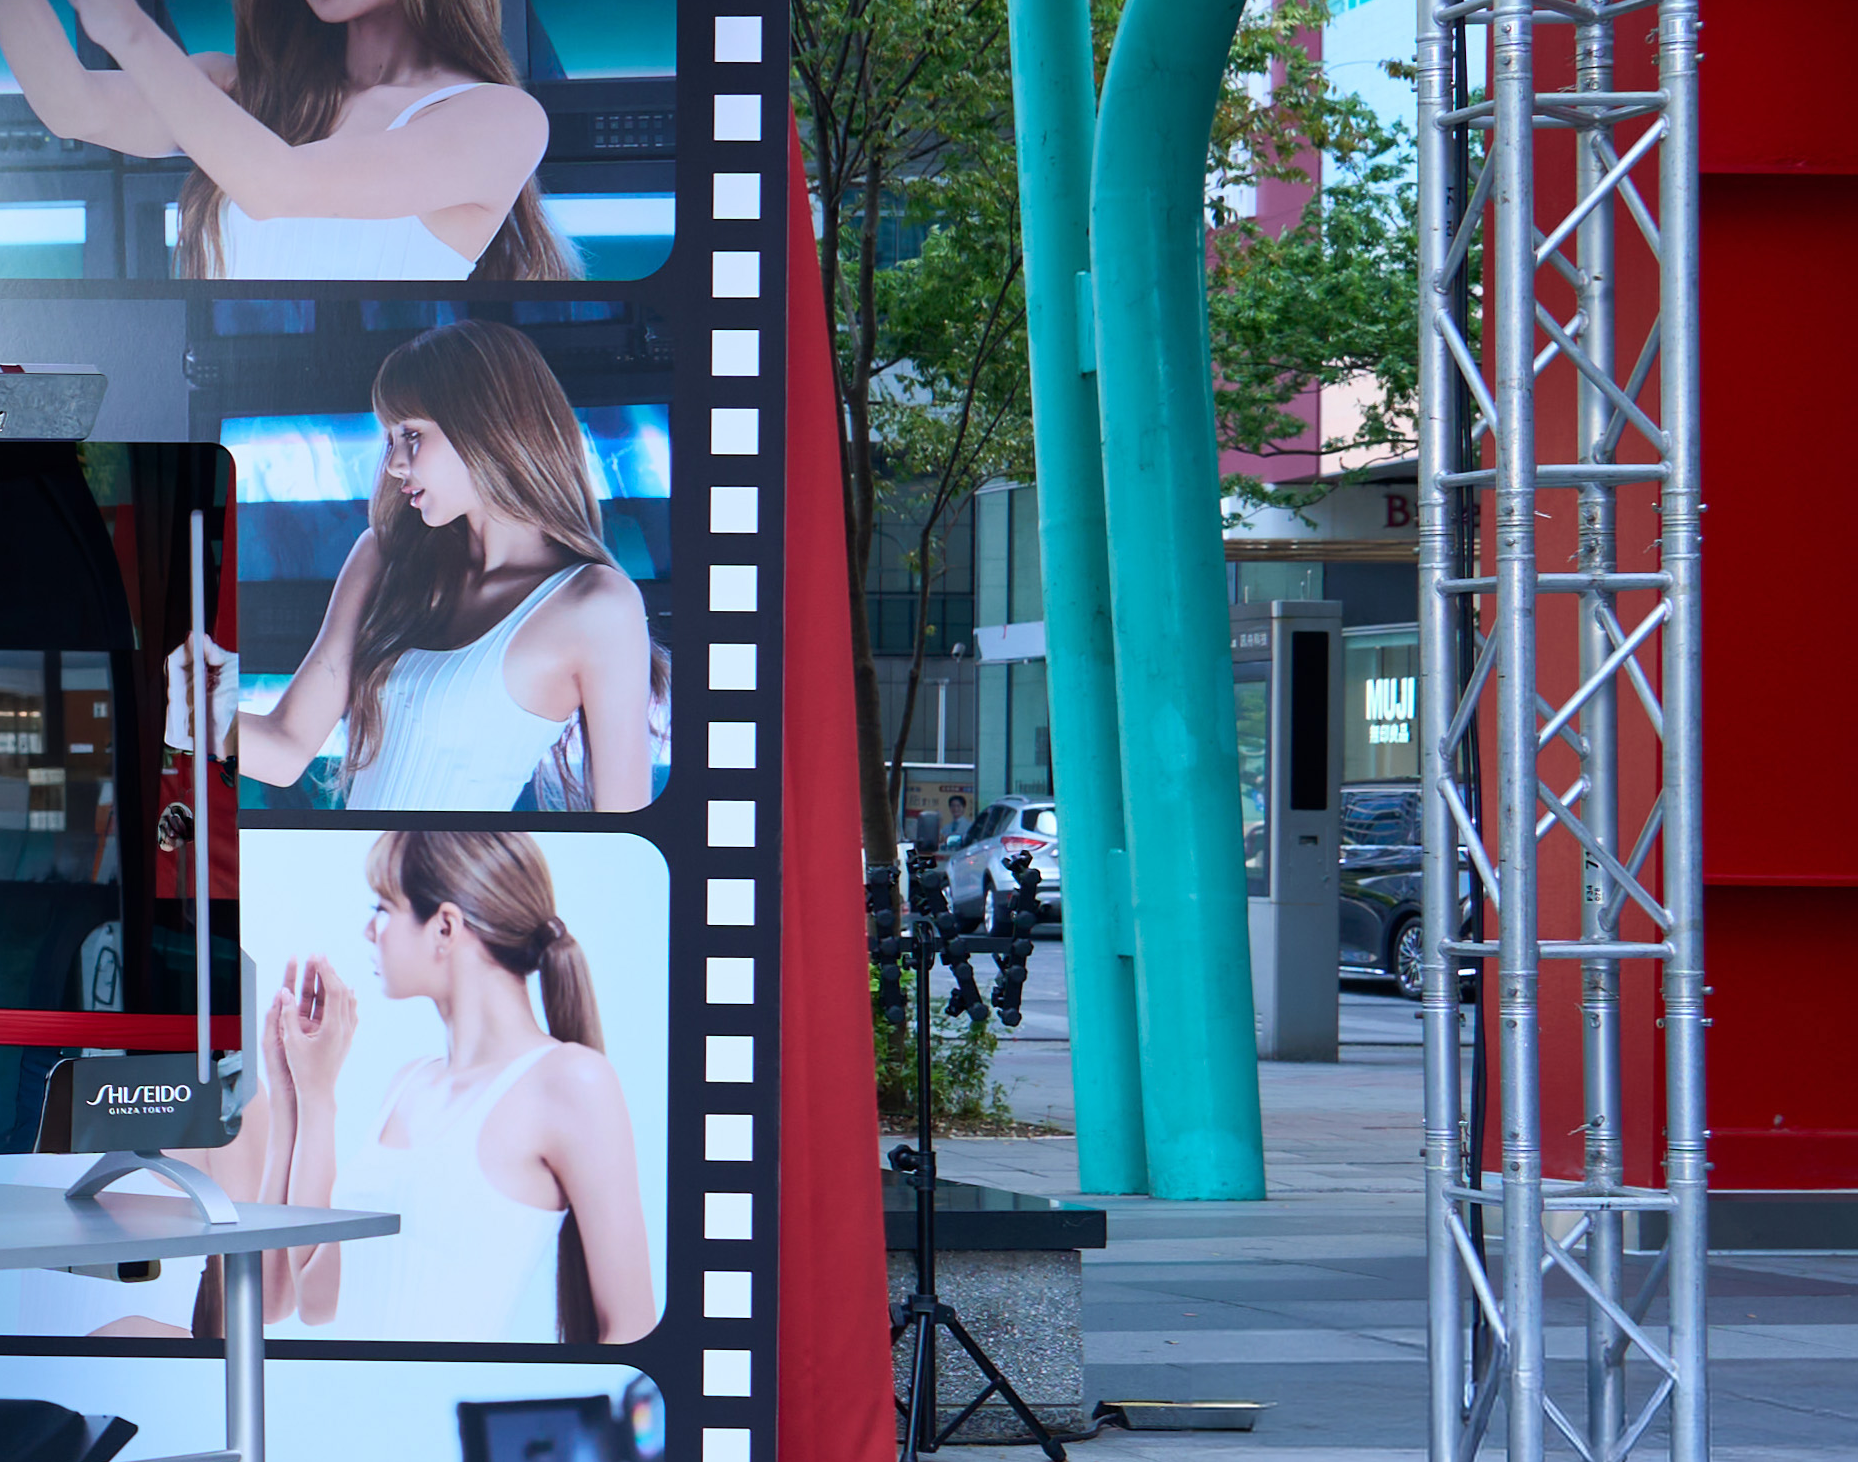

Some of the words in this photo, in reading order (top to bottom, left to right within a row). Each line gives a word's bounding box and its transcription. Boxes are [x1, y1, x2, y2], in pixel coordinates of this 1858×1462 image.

[1365, 677, 1415, 720] MUJI
[86, 1084, 192, 1105] SHISEIDO
[108, 1106, 141, 1115] GINZA
[142, 1105, 175, 1115] TOKYO
